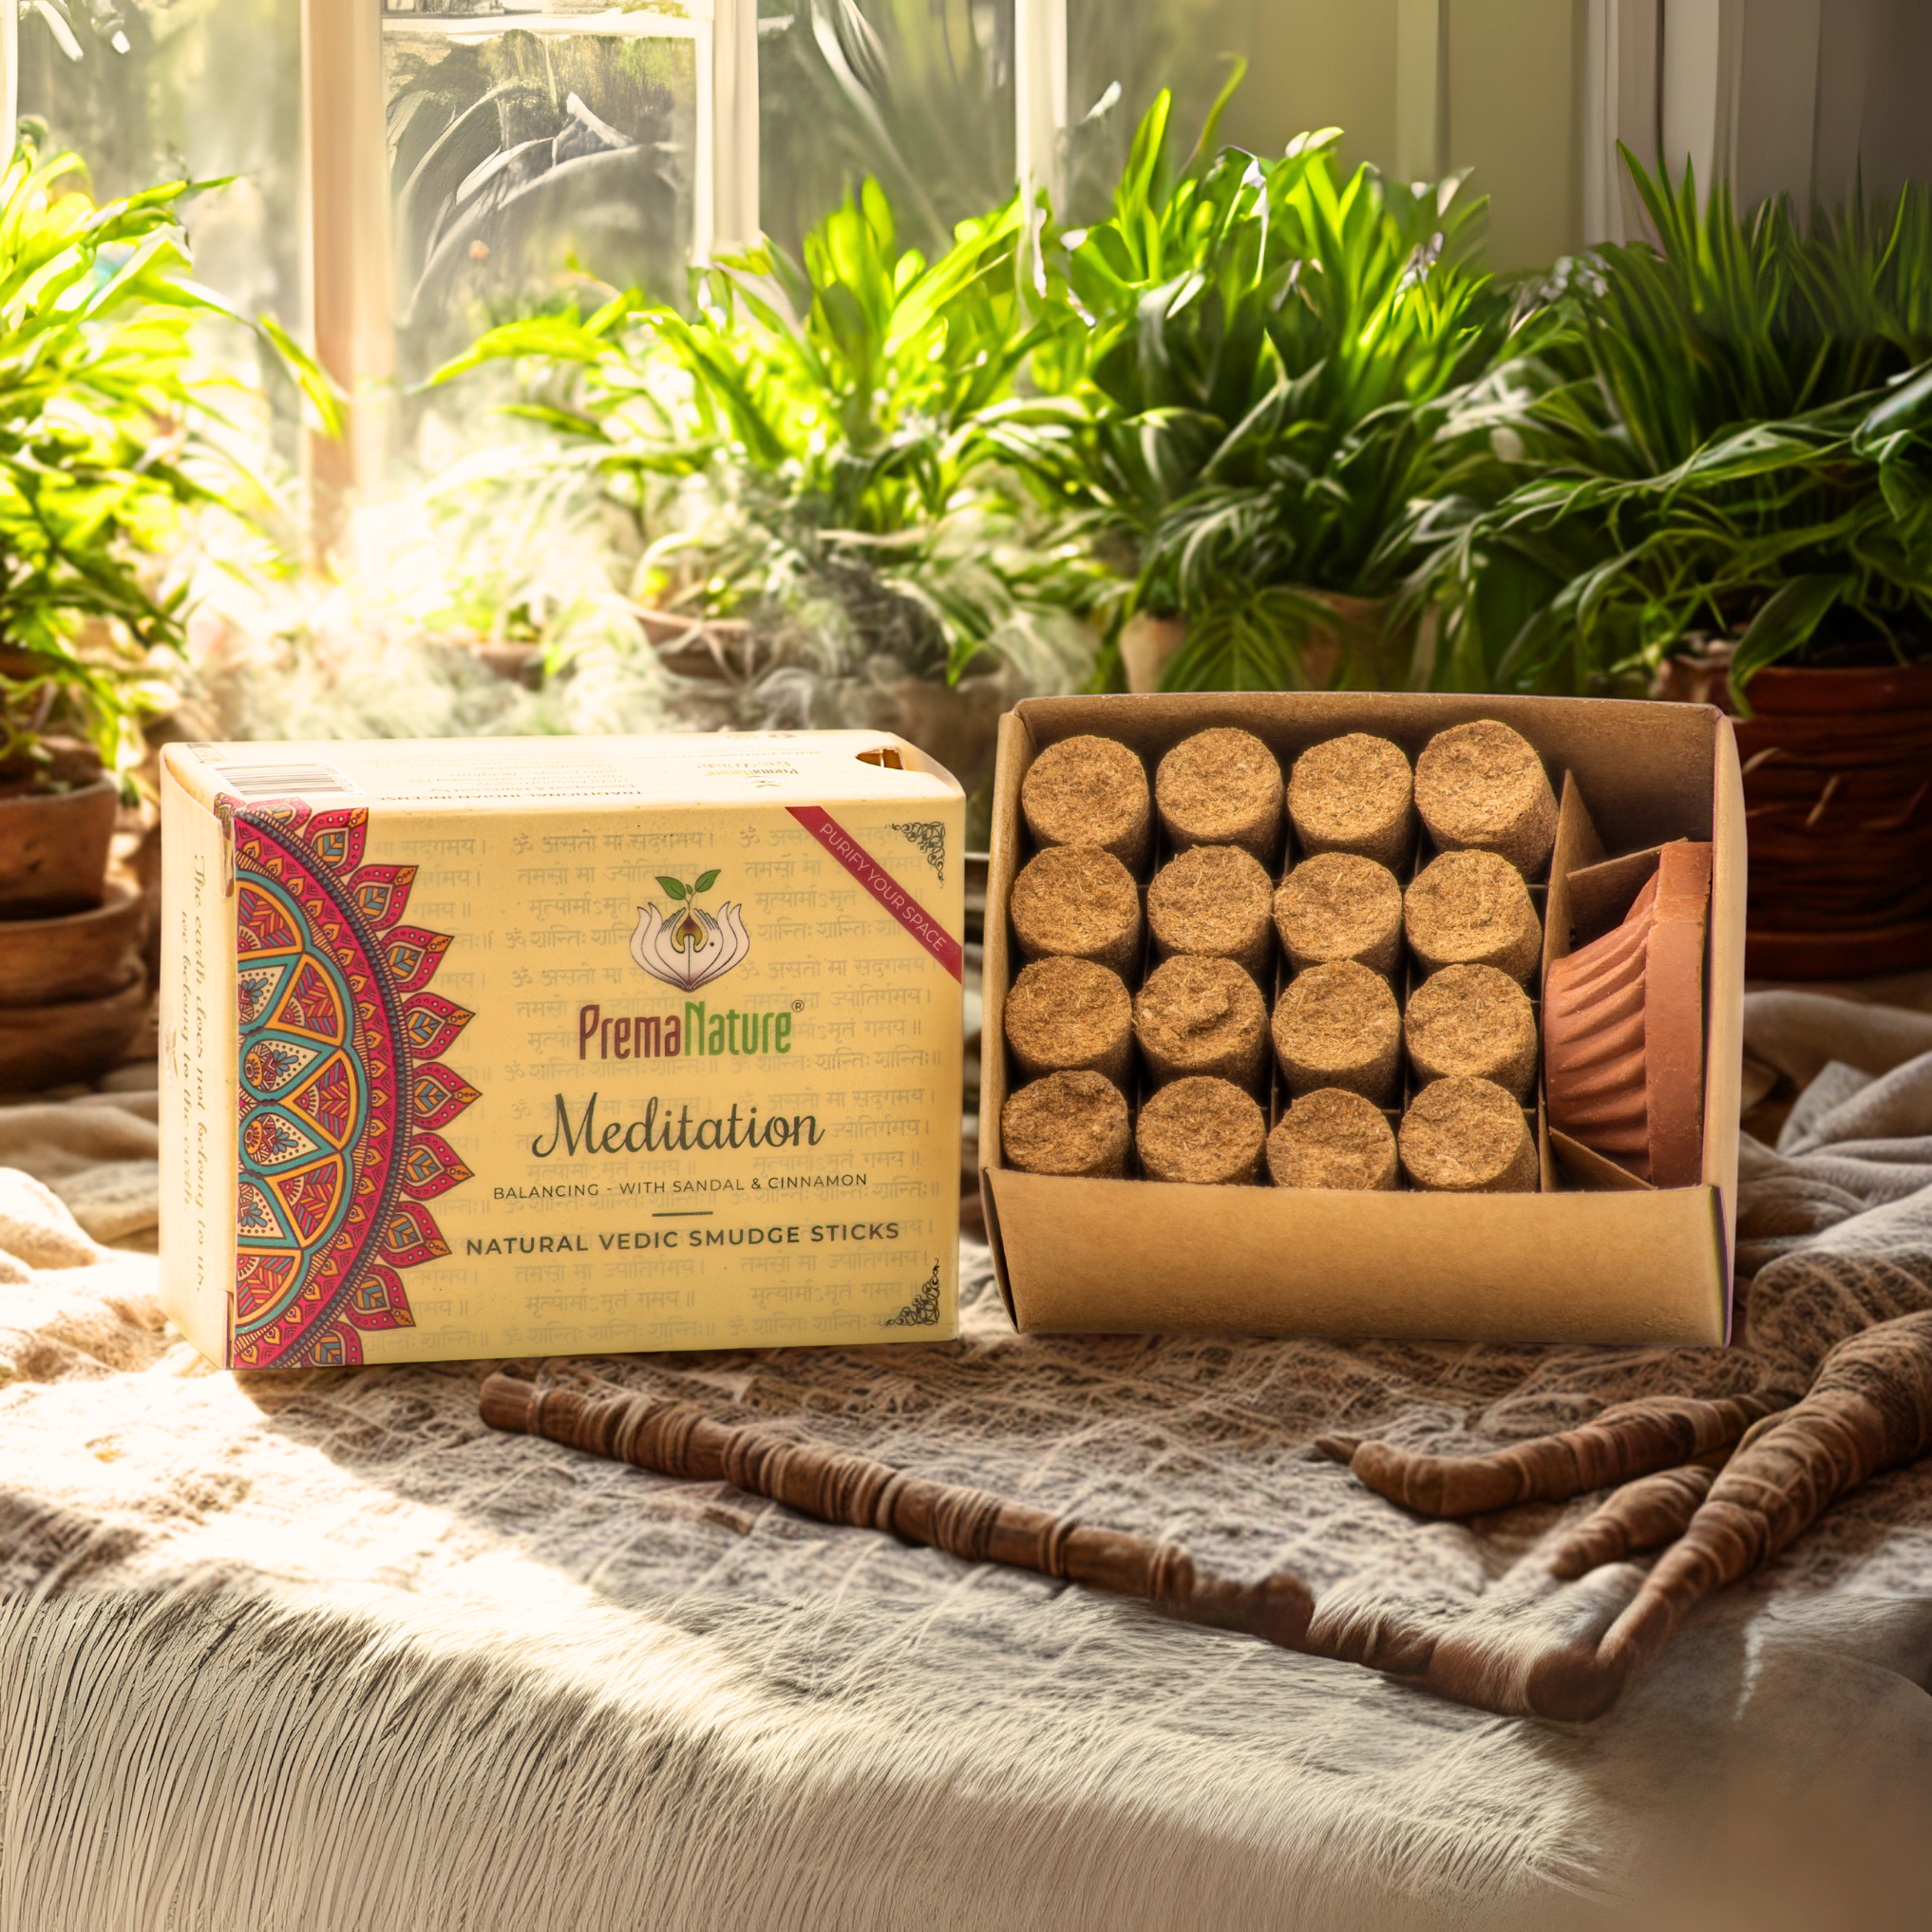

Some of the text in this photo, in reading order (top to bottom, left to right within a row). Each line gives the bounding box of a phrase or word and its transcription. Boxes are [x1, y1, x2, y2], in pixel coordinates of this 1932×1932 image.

[194, 855, 206, 908] The
[820, 823, 870, 871] PURIFY
[868, 868, 905, 910] YOUR
[902, 906, 947, 952] SPACE
[182, 911, 188, 946] we
[195, 916, 205, 988] earth
[180, 955, 192, 1045] belong
[196, 995, 207, 1058] does
[183, 1052, 191, 1081] to
[197, 1068, 206, 1113] not
[183, 1089, 192, 1128] the
[532, 1092, 825, 1158] Meditation
[195, 1122, 208, 1211] belong
[494, 1184, 598, 1200] BALANCING
[619, 1181, 665, 1195] WITH
[673, 1179, 746, 1193] SANDAL
[750, 1178, 762, 1190] &
[768, 1174, 867, 1189] CINNAMON
[198, 1220, 207, 1247] to
[466, 1235, 588, 1256] NATURAL
[598, 1230, 679, 1250] VEDIC
[690, 1226, 801, 1247] SMUDGE
[811, 1222, 899, 1242] STICKS
